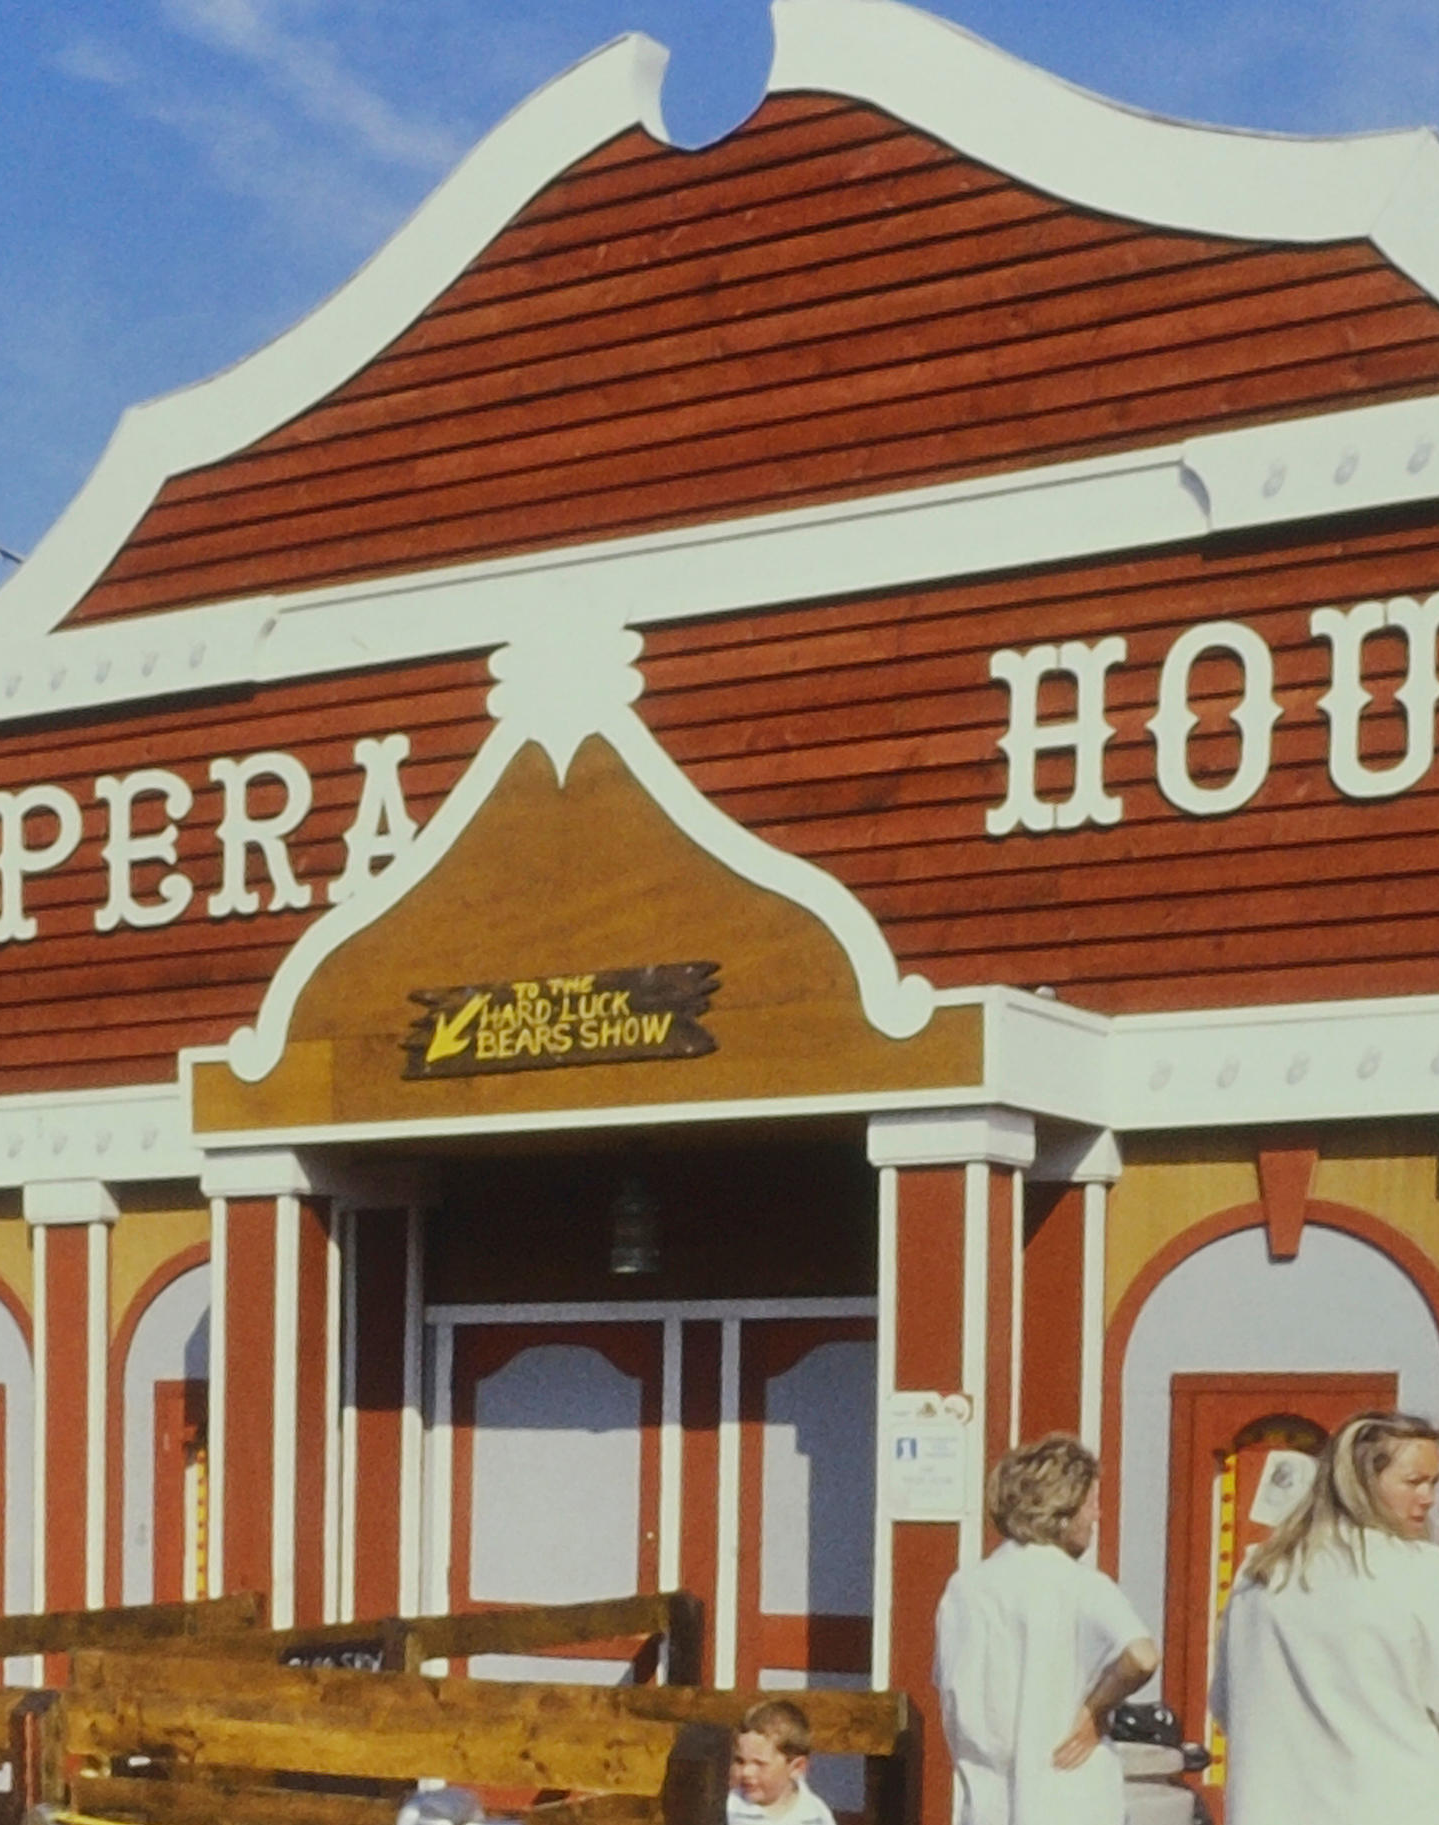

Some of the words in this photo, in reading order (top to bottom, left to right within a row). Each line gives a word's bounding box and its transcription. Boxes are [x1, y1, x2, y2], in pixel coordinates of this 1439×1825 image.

[512, 981, 540, 998] TO
[547, 974, 596, 996] THE
[479, 998, 552, 1029] HARD
[560, 990, 630, 1022] LUCK
[474, 1022, 574, 1060] BEARS
[579, 1011, 673, 1050] SHOW
